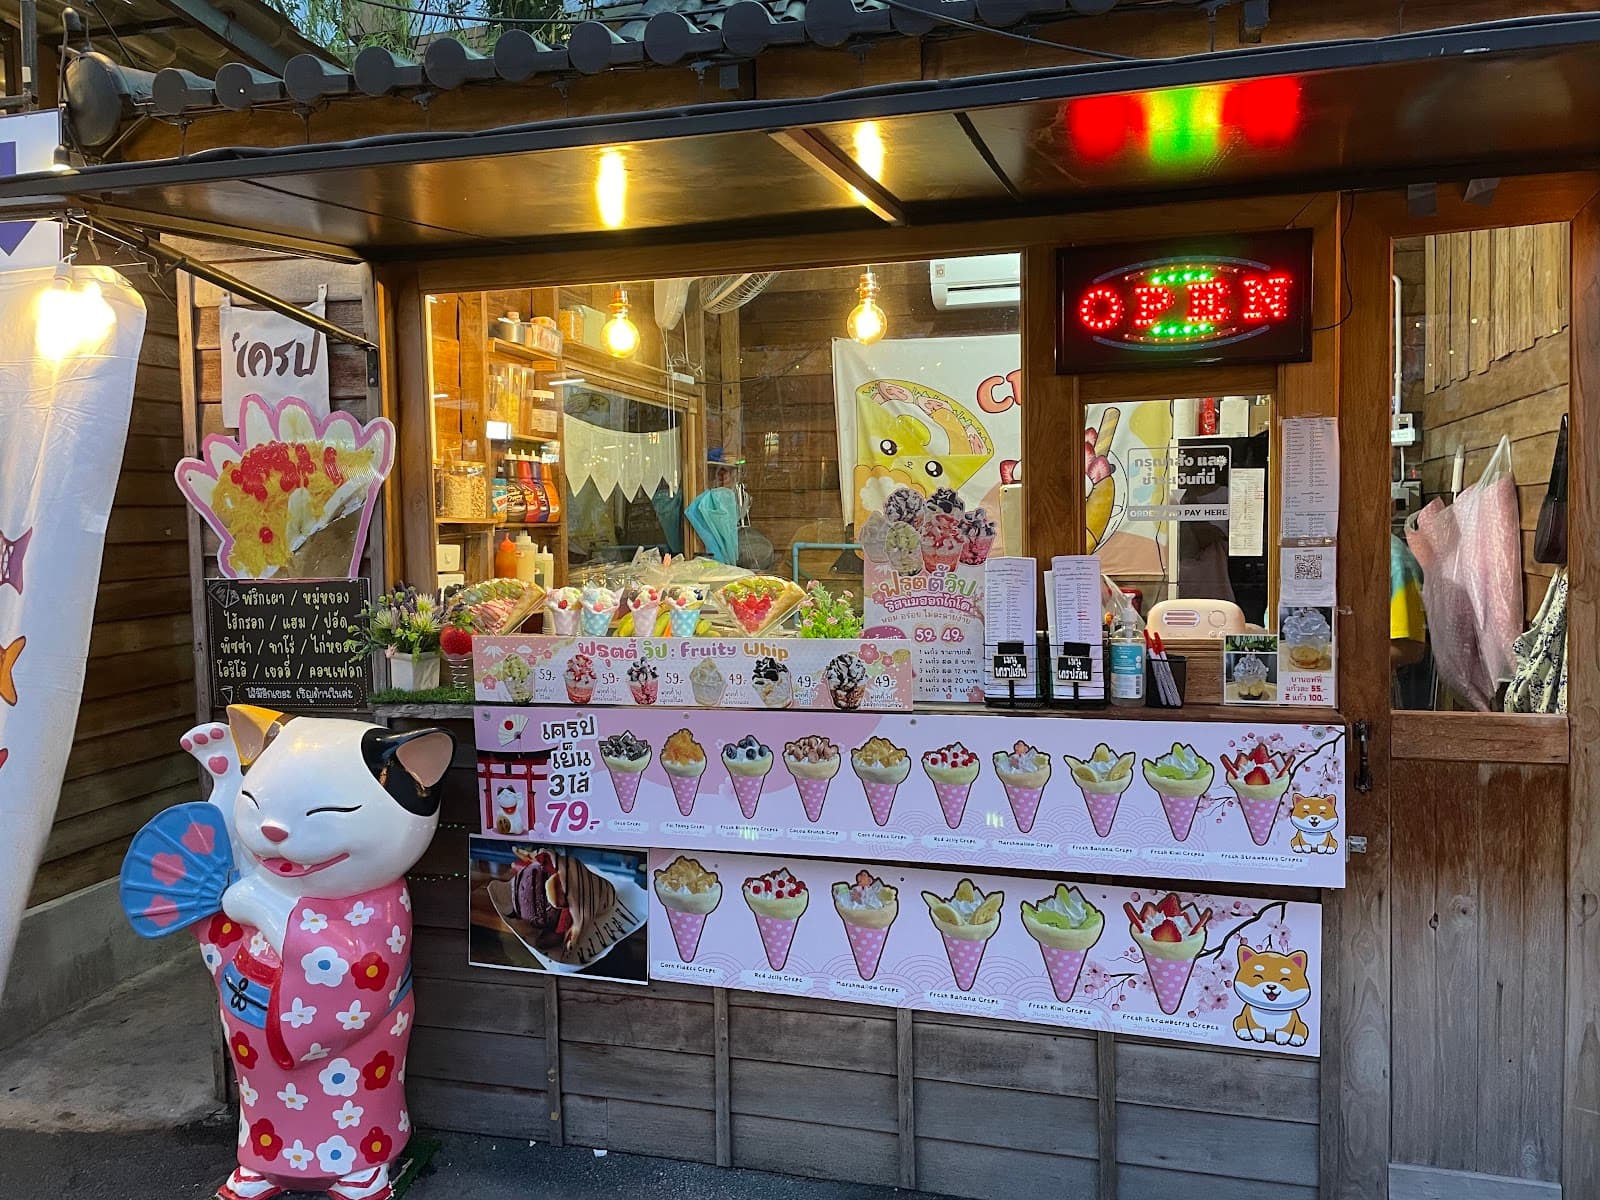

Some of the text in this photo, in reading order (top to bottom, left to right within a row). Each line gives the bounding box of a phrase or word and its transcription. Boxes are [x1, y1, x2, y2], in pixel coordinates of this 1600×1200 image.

[1080, 274, 1289, 330] OPEN
[242, 588, 285, 605] พริกเผา
[224, 610, 264, 629] ไส้กรอก
[283, 617, 306, 630] แฮม
[324, 610, 347, 635] ปูอัด
[269, 635, 295, 654] ทาโร่
[310, 633, 356, 654] ไก่หยอง
[680, 642, 736, 659] Fruity
[743, 641, 789, 662] Whip
[217, 660, 247, 678] โอริโอ้
[265, 655, 291, 678] เยลลี่
[543, 716, 595, 740] เครป
[553, 742, 591, 769] เย็น
[547, 801, 600, 832] 79.-
[950, 994, 976, 1002] Banana
[1122, 1013, 1142, 1021] Fresh
[1145, 1016, 1190, 1028] Strawberry
[1192, 1021, 1219, 1031] Crepes
